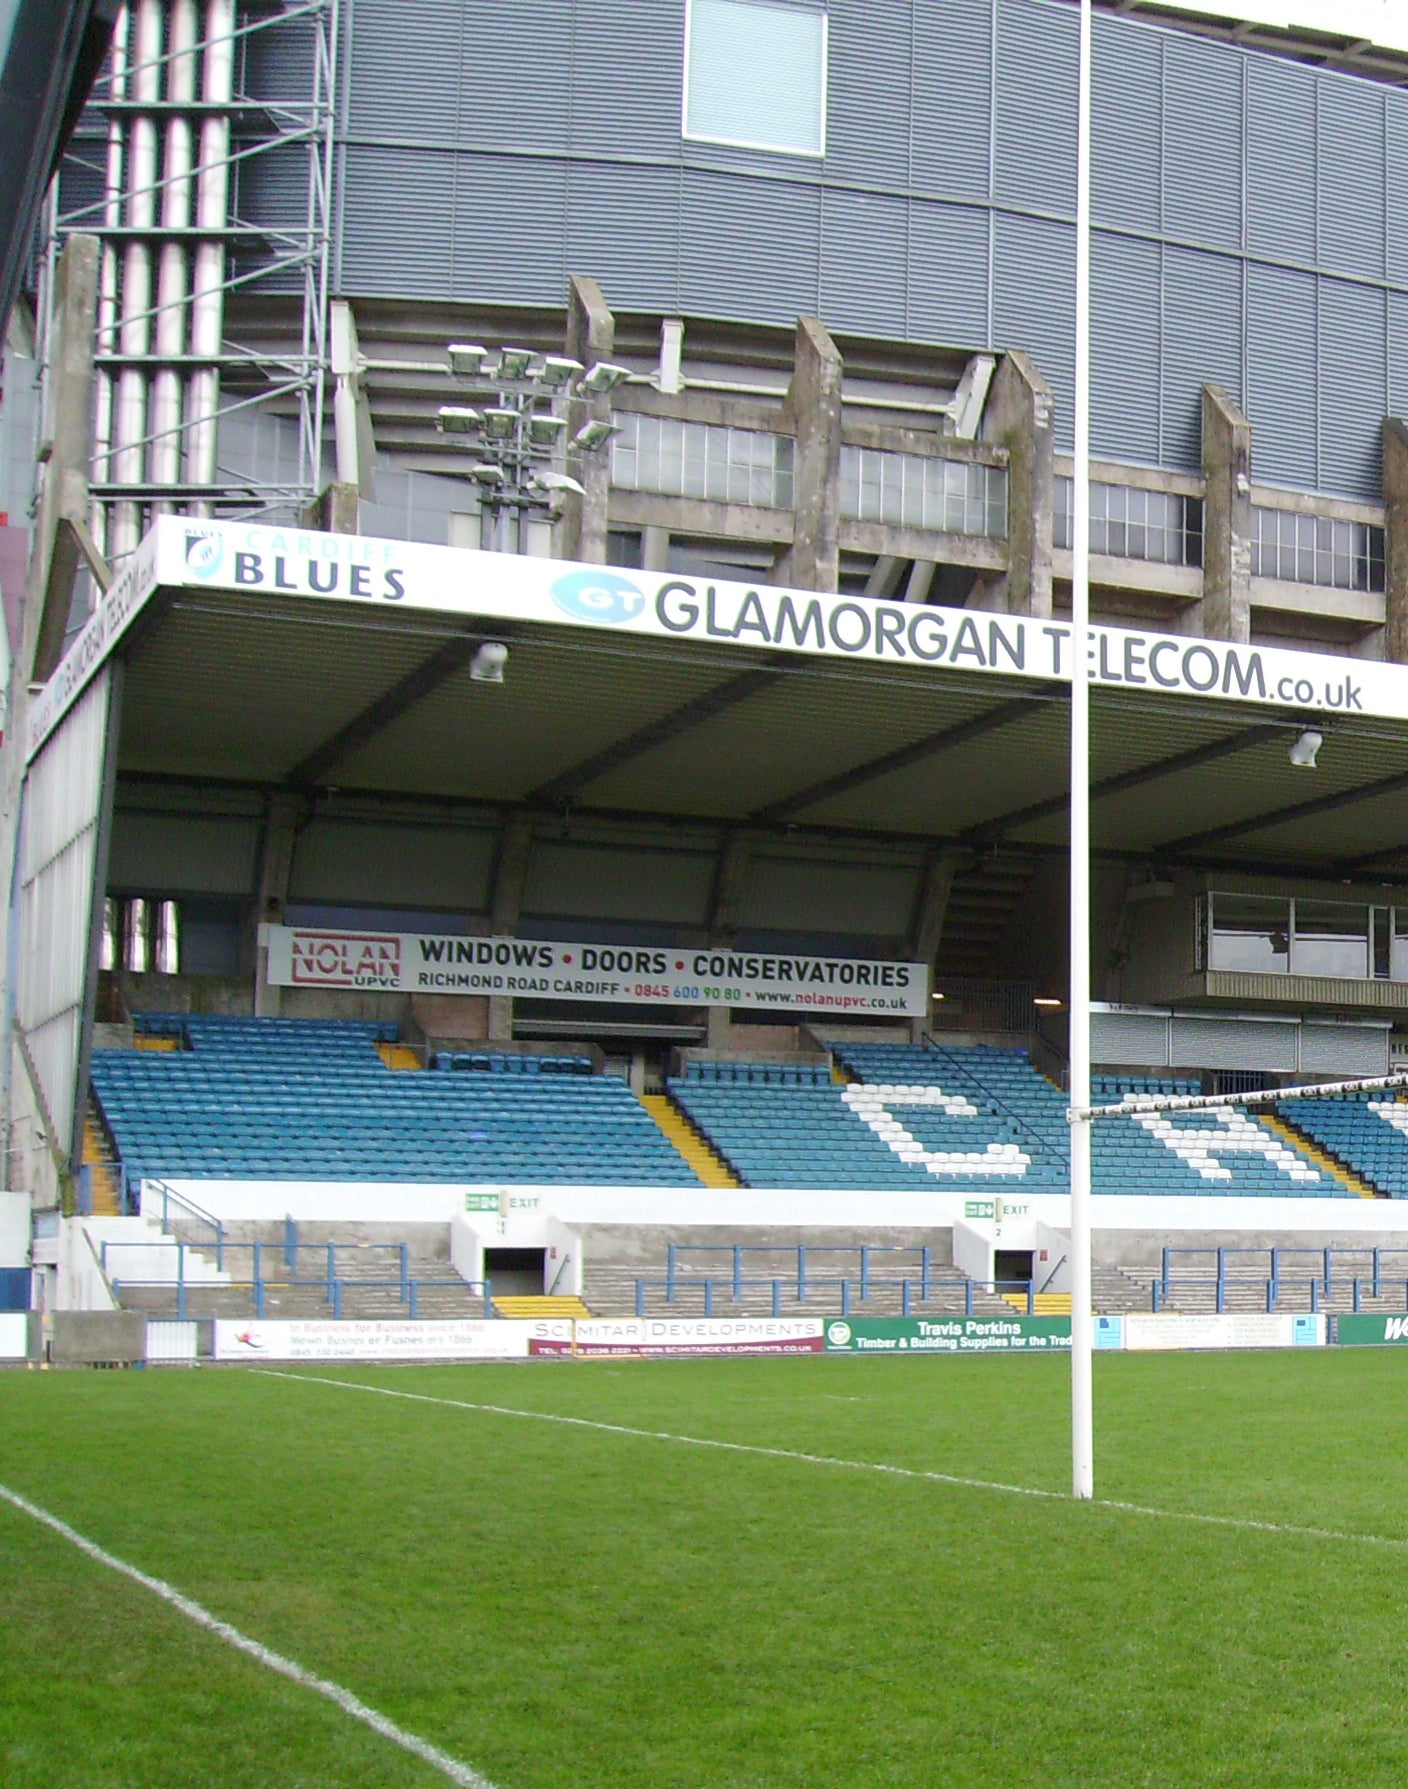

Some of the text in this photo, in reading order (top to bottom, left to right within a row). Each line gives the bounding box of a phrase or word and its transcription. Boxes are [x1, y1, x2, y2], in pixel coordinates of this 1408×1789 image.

[246, 529, 397, 564] CARDIFF
[234, 551, 405, 601] BLUES
[579, 586, 643, 613] GT
[654, 581, 1026, 671] GLAMORGAN
[292, 940, 401, 977] NOLAN
[418, 939, 911, 988] WINDOWS DOORS CONSERVATORIES
[354, 976, 401, 988] UPVC
[417, 972, 908, 1011] RICHMOND ROAD CARDIFF 0845 600 90 80 www.nolanupvc.co.uk
[509, 1198, 539, 1208] EXIT
[1003, 1205, 1029, 1215] EXIT
[375, 1322, 423, 1333] Business
[535, 1322, 817, 1338] SCIMITAR DEVELOPMENTS
[917, 1320, 1022, 1336] Travis Perkins
[855, 1337, 897, 1349] Timber
[898, 1337, 908, 1348] &
[910, 1336, 958, 1350] Building
[959, 1335, 1009, 1349] Supplies
[1010, 1335, 1027, 1347] for
[1028, 1335, 1047, 1347] the
[1049, 1335, 1073, 1347] Trad
